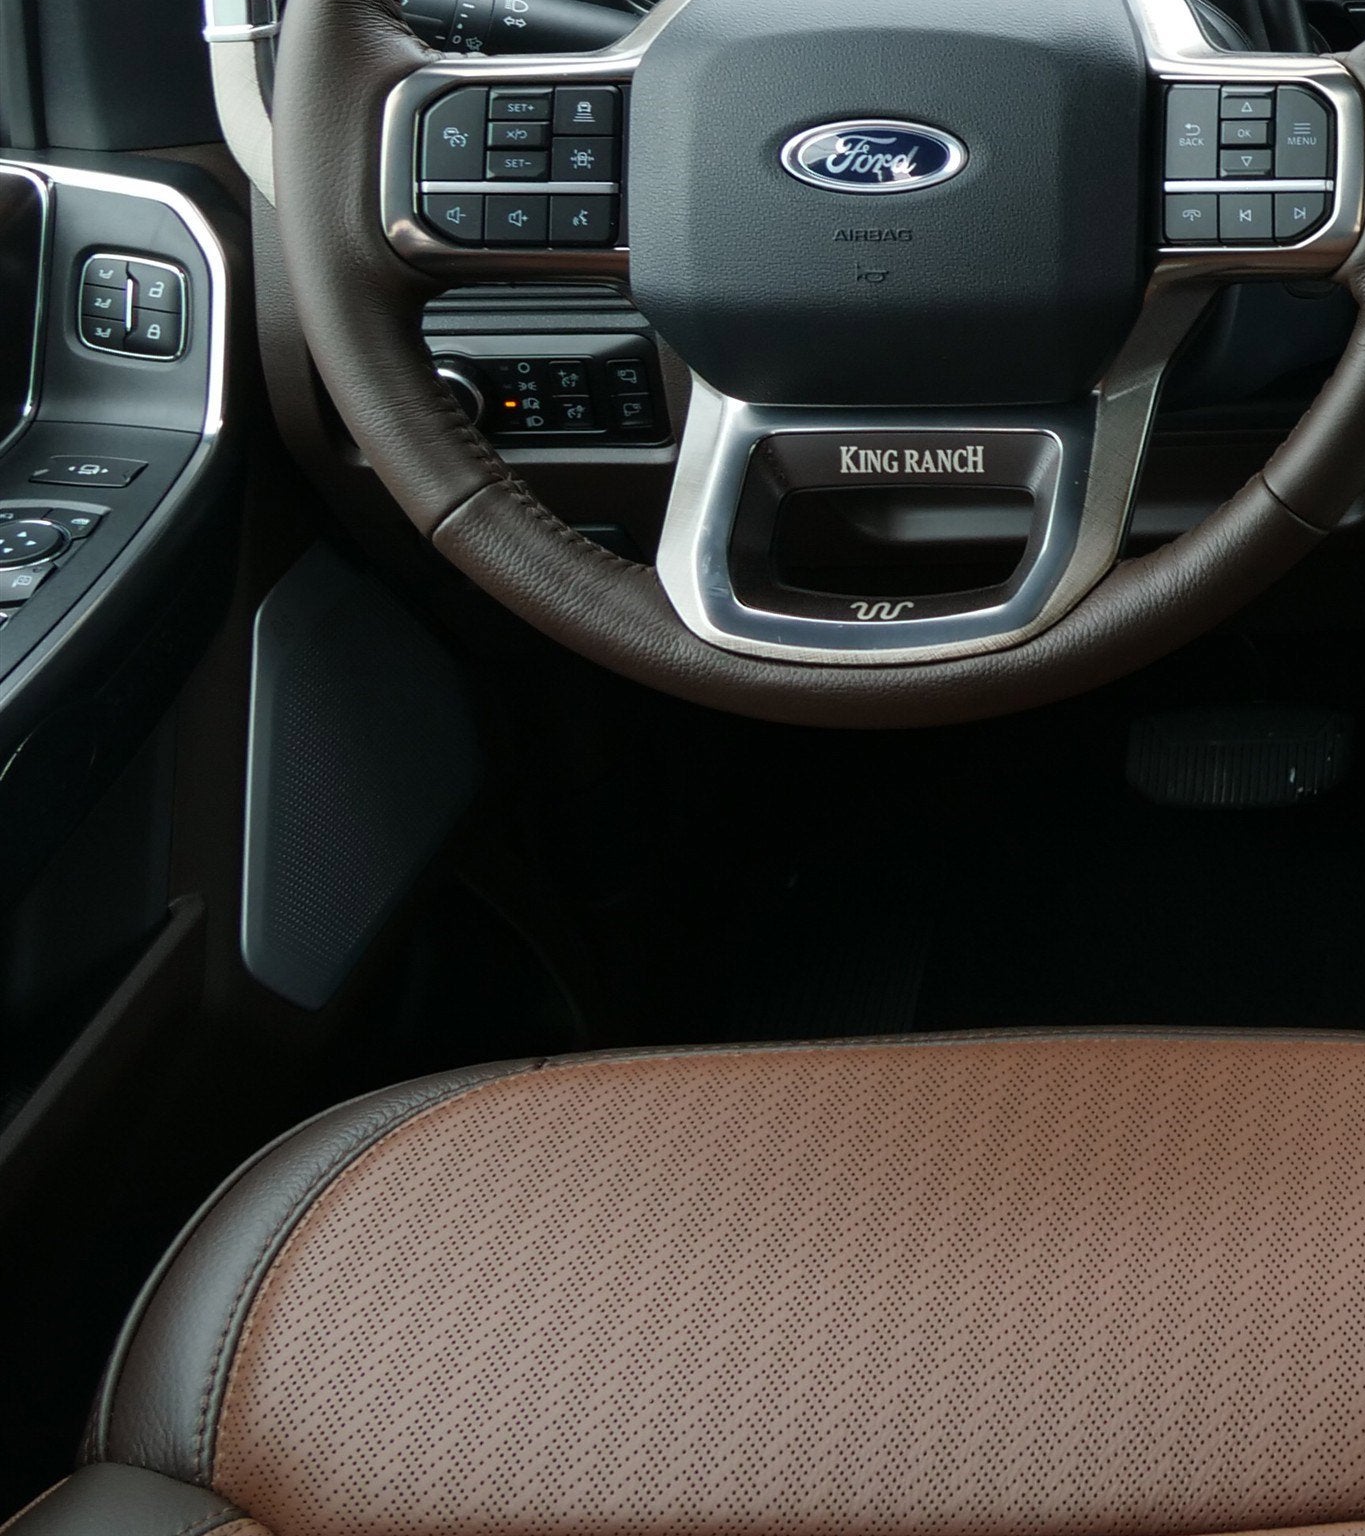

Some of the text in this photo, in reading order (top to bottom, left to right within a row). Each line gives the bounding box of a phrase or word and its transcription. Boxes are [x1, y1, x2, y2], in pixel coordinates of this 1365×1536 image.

[1237, 129, 1251, 138] OK
[1179, 137, 1204, 146] BACK
[1287, 137, 1317, 146] MENU
[826, 134, 919, 175] Ford
[832, 229, 914, 242] AIRBAG
[840, 445, 985, 474] KING RANCH
